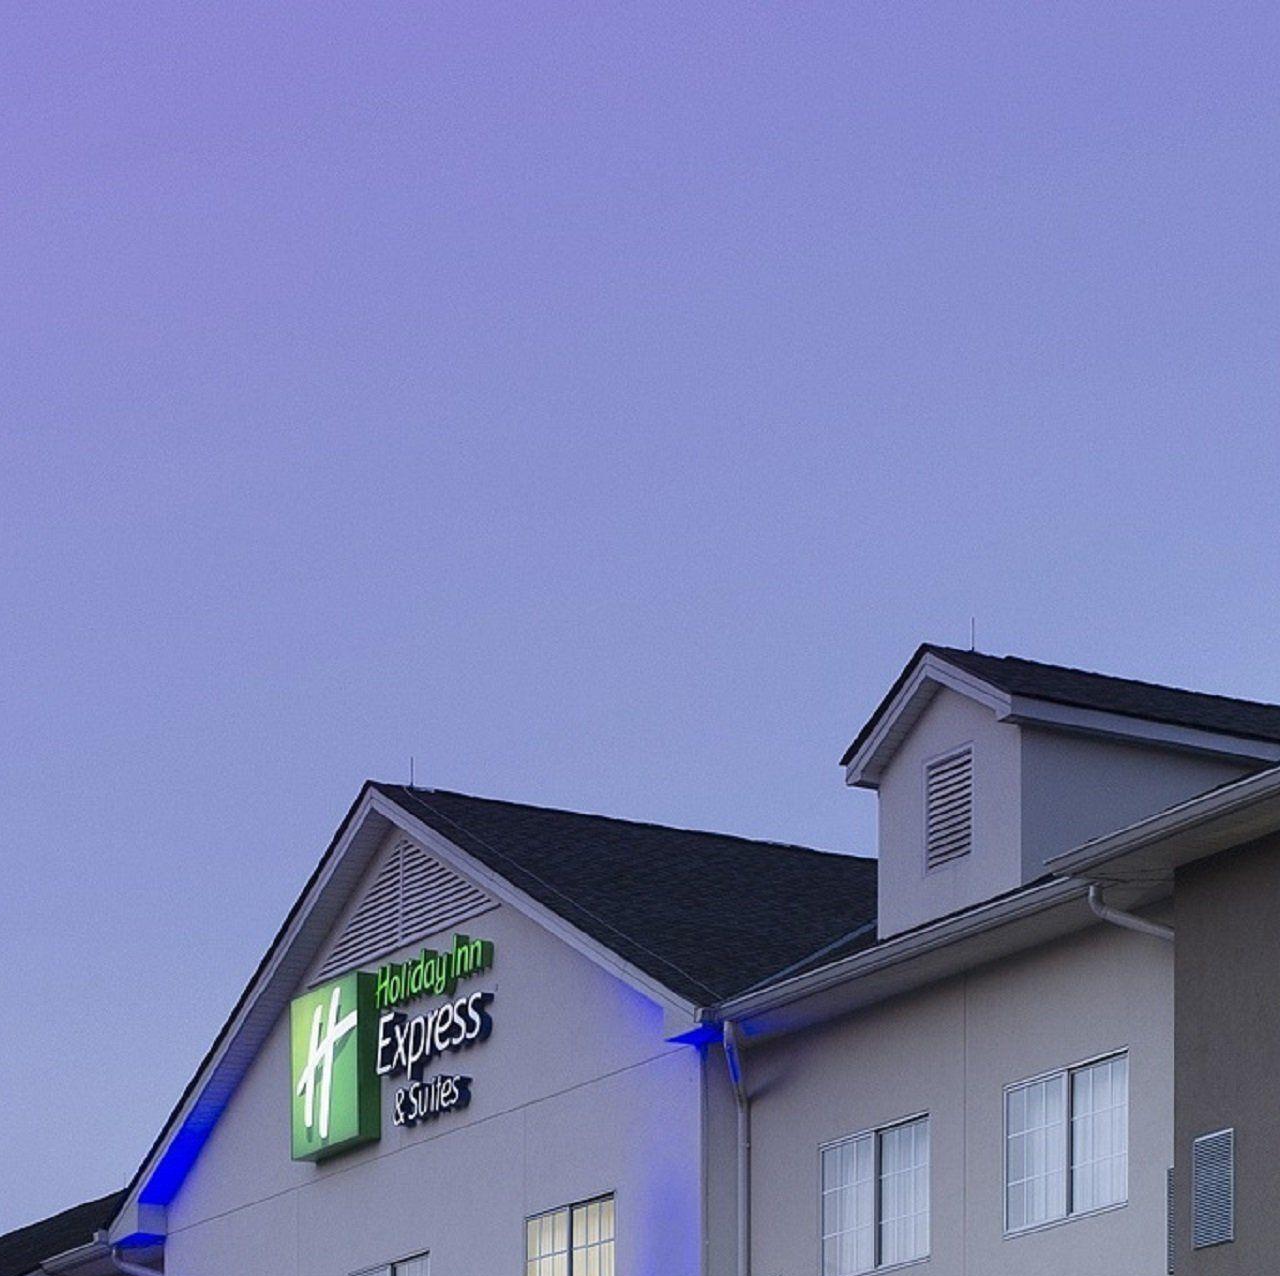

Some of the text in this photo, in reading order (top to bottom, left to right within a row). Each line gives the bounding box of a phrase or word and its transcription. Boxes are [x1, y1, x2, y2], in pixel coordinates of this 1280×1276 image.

[375, 933, 483, 1009] Holiday Inn
[376, 992, 482, 1080] Express
[393, 1074, 461, 1126] & Suites
